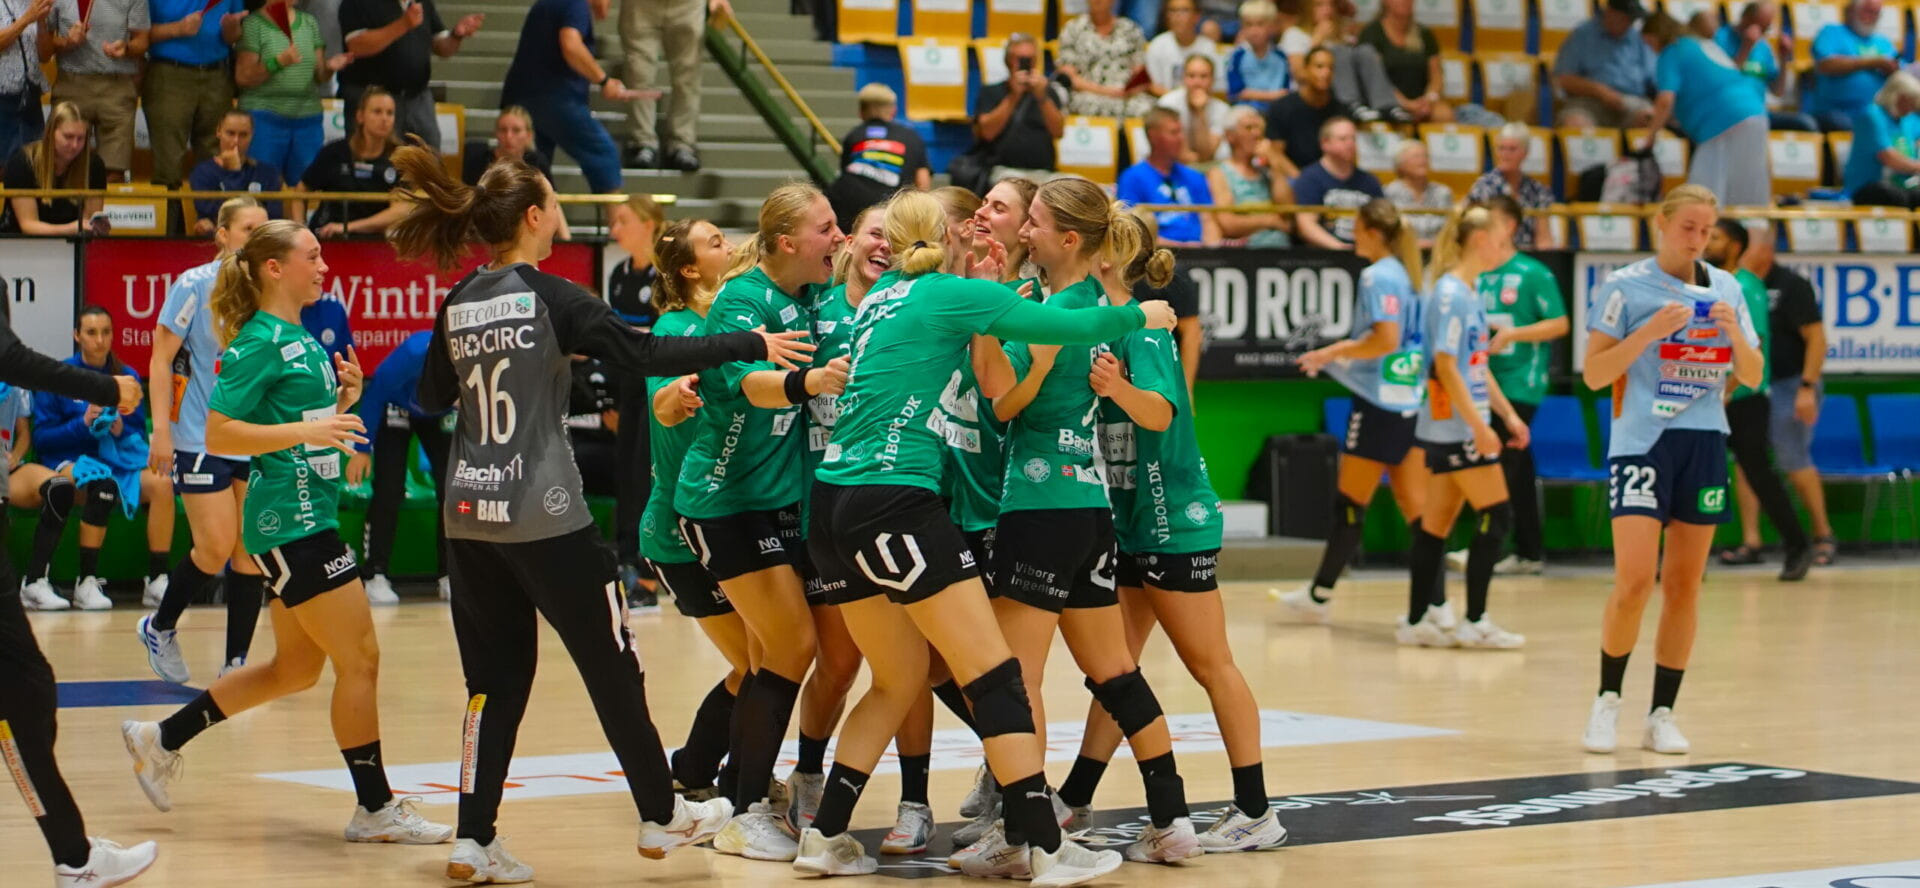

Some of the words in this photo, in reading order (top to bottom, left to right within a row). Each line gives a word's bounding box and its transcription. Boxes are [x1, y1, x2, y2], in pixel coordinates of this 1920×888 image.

[451, 301, 511, 327] TEFCOLD
[1256, 268, 1354, 338] ROD
[466, 358, 516, 445] 16
[455, 459, 502, 481] Bach
[1623, 464, 1656, 496] 22
[477, 499, 512, 523] BAK
[1147, 460, 1171, 545] VIBORG.DK
[1015, 561, 1056, 584] Viborg
